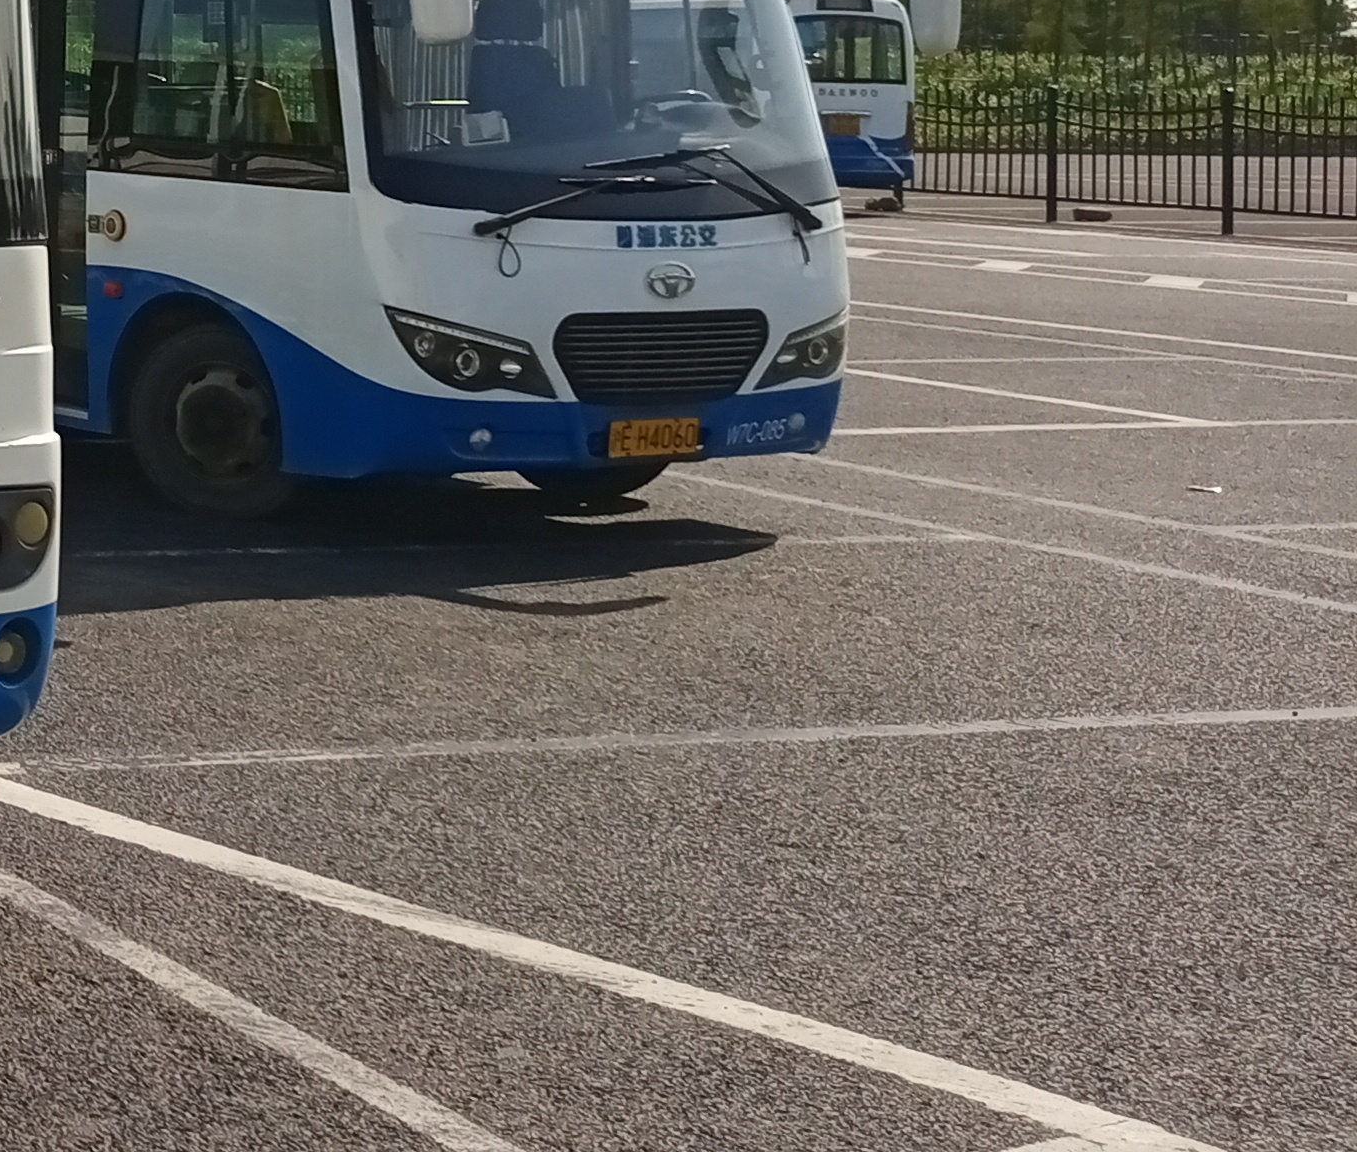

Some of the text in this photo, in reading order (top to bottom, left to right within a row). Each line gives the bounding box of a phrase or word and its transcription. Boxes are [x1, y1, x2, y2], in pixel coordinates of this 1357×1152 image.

[818, 87, 878, 97] DAEWOO
[636, 224, 718, 248] 浦东公交
